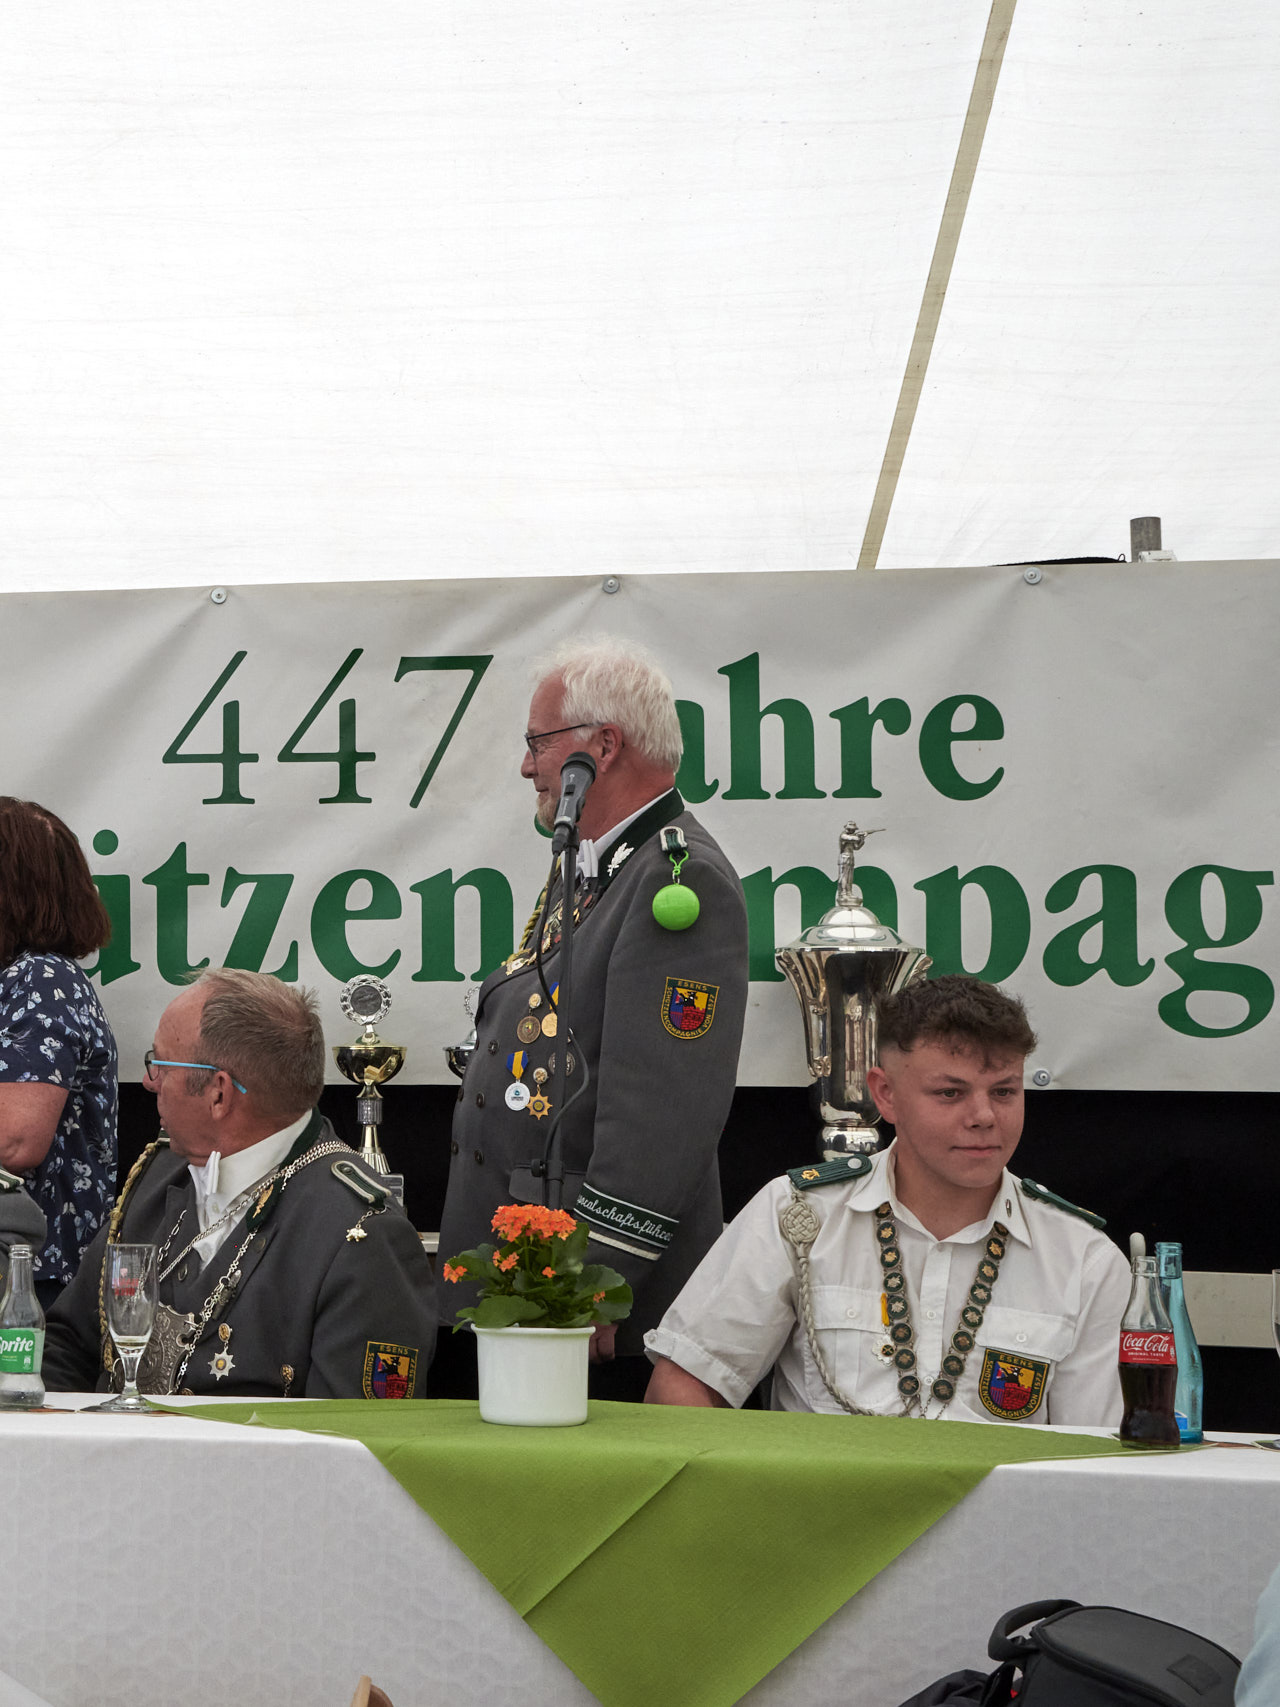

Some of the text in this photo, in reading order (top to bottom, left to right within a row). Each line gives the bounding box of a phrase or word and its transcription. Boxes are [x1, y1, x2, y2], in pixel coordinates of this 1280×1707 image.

[162, 648, 494, 808] 447
[677, 980, 708, 992] ESENS
[379, 1344, 409, 1355] ESENS
[1122, 1333, 1170, 1353] Coca-Cola
[999, 1354, 1034, 1368] ESENS
[1027, 1393, 1039, 1409] VON
[1034, 1372, 1043, 1390] 1577
